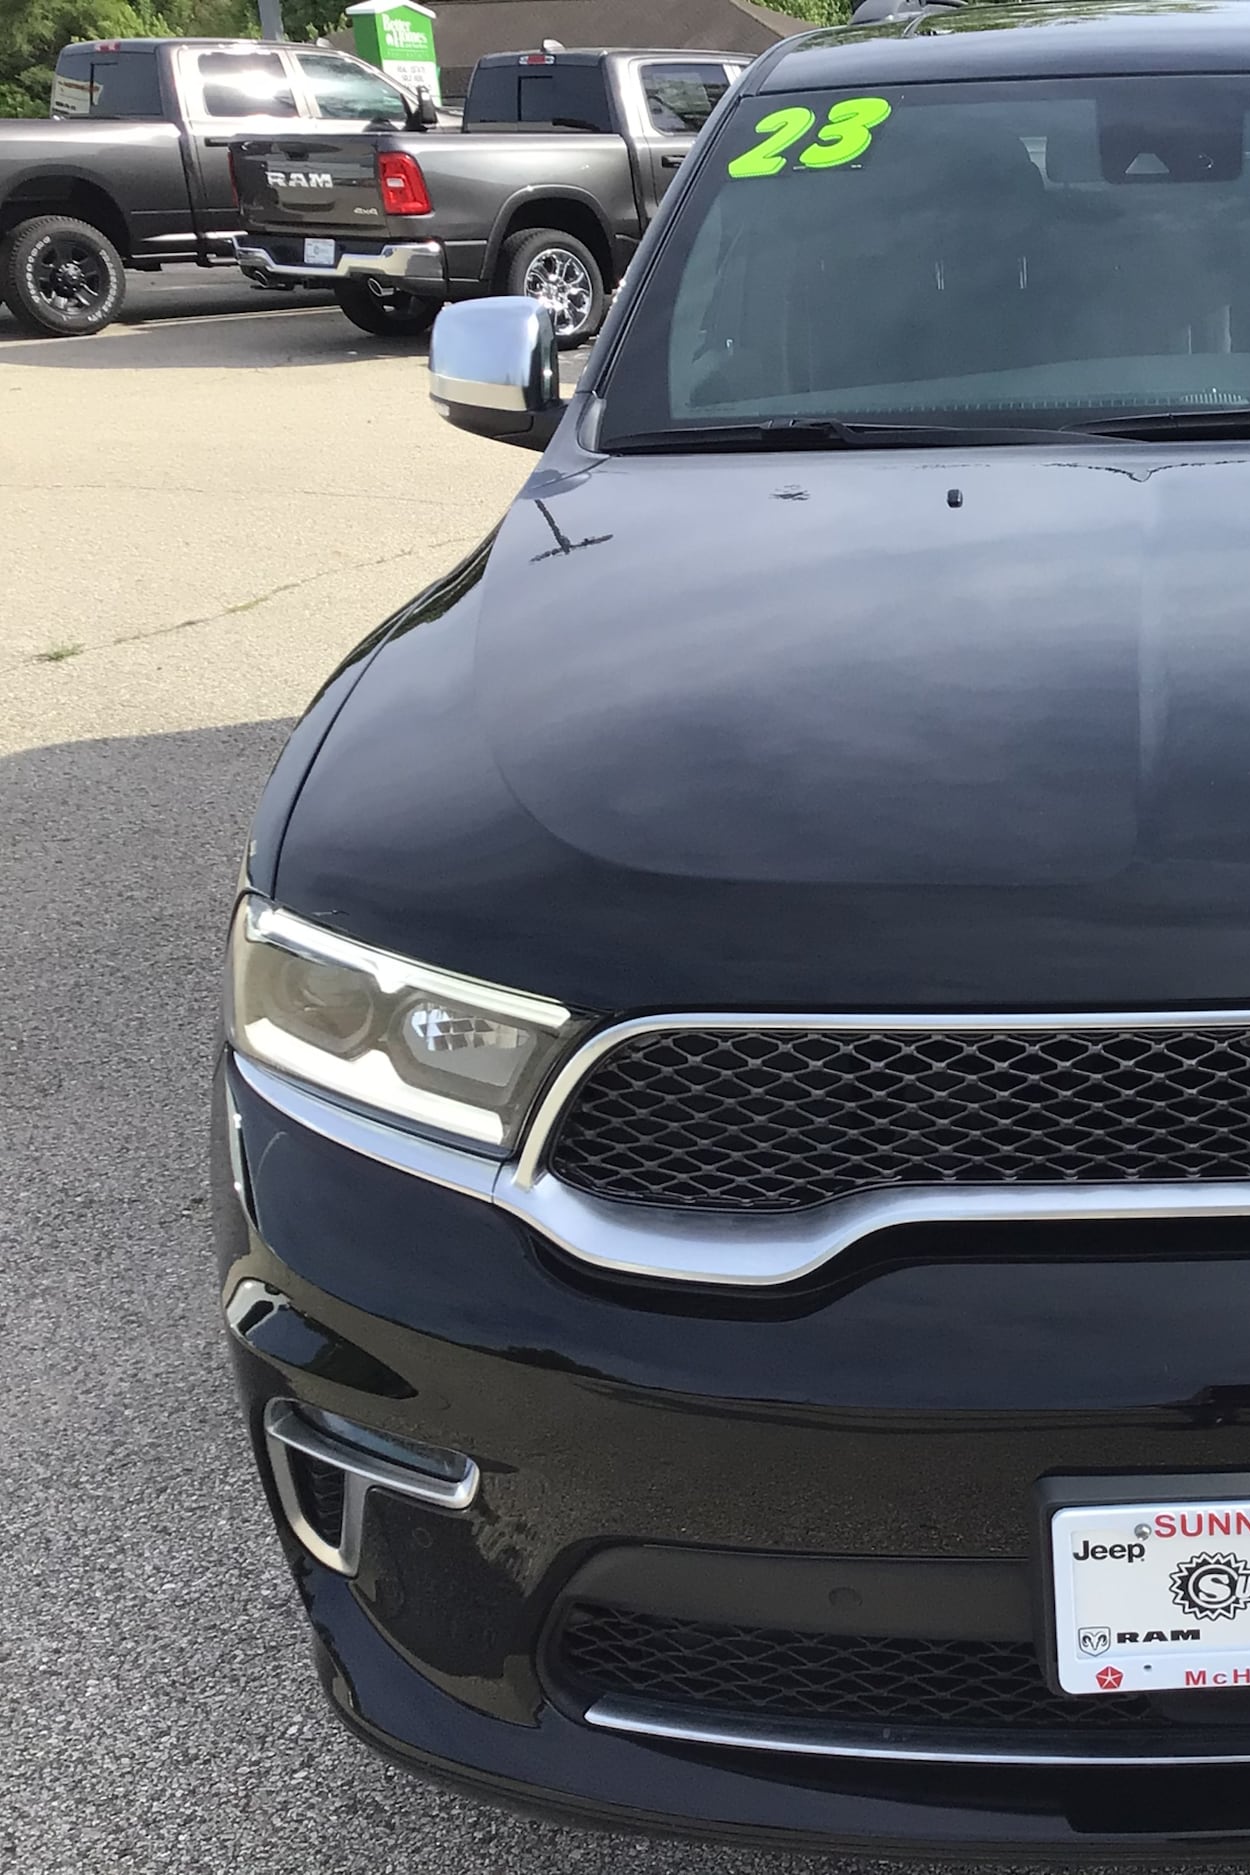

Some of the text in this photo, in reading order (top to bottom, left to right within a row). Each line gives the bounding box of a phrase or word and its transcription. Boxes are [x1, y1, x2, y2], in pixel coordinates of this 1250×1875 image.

[382, 13, 411, 31] Better
[728, 96, 892, 178] 23
[265, 170, 334, 188] RAM
[1072, 1539, 1146, 1563] Jeep
[1116, 1628, 1201, 1644] RAM
